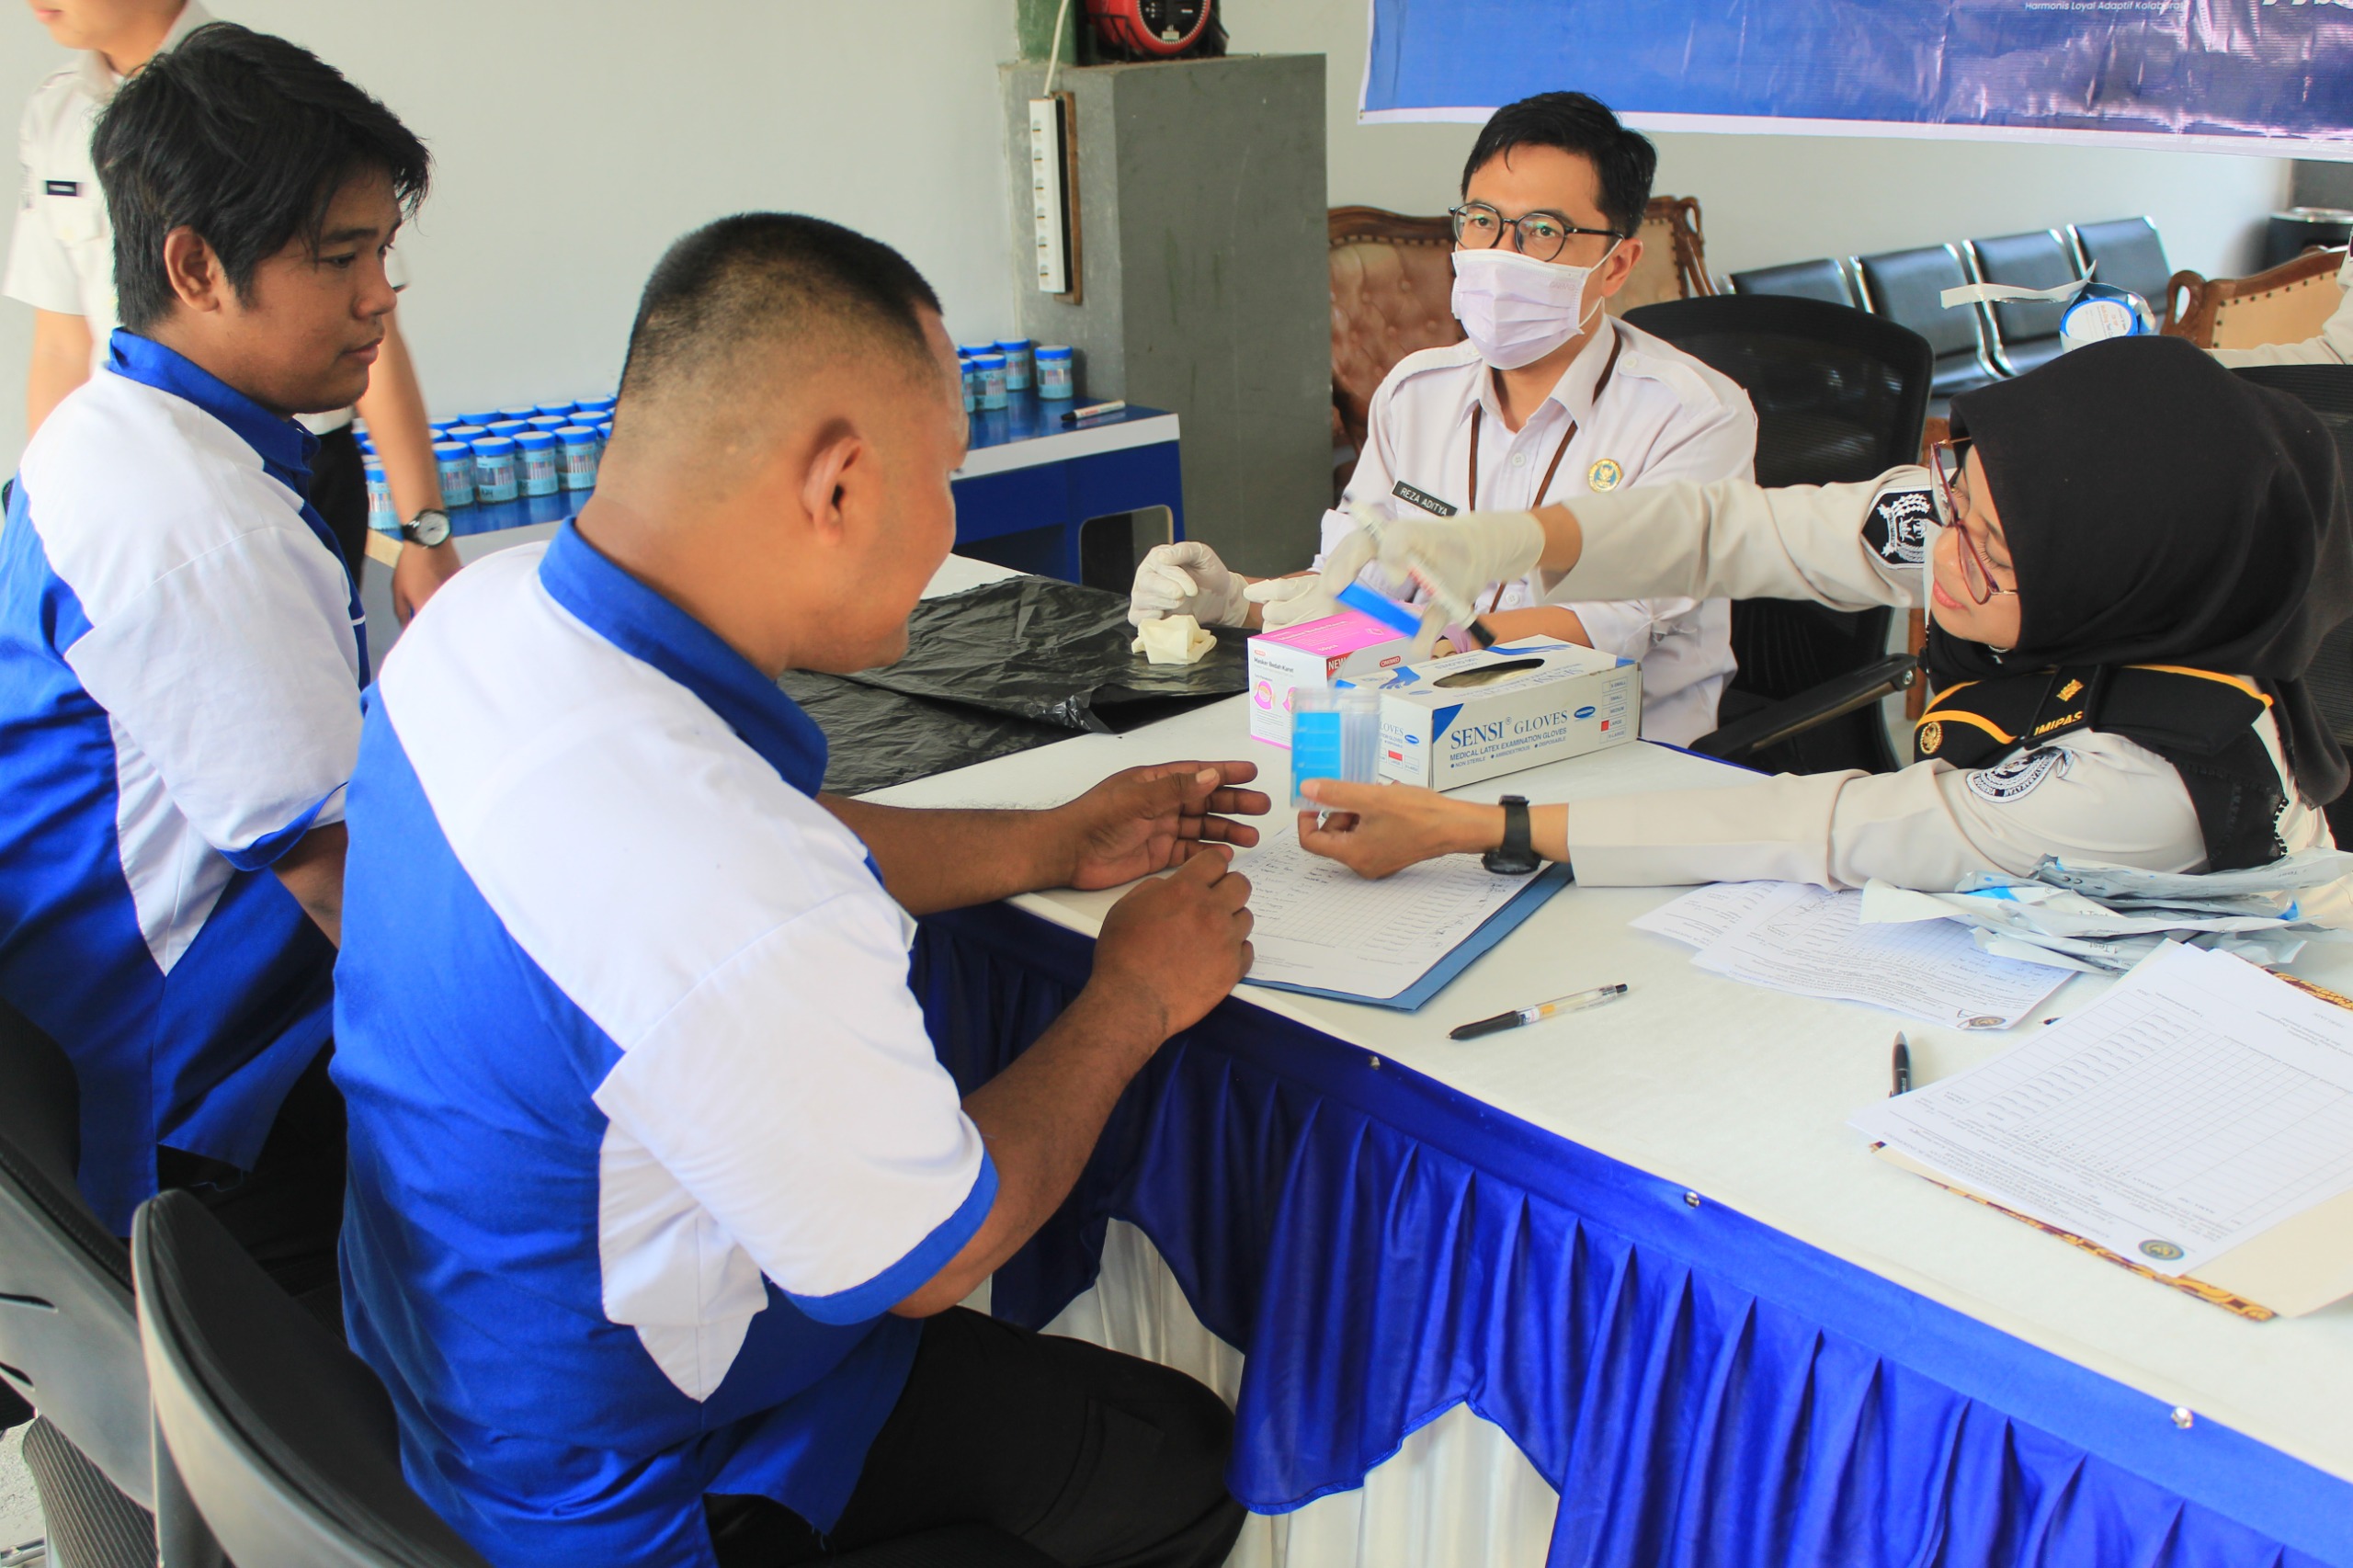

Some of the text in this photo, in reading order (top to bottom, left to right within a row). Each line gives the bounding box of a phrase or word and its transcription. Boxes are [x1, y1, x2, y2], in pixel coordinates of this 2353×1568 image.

[2025, 1, 2069, 11] Harmonis
[2071, 1, 2097, 13] Loyal
[2097, 1, 2133, 13] Adaptif
[1400, 487, 1448, 517] REZA ADITYA
[1254, 656, 1269, 665] Masker
[1380, 721, 1404, 736] LOVES
[1514, 710, 1568, 735] GLOVES
[1609, 719, 1622, 727] LARGE
[2033, 710, 2084, 736] IMIPAS
[1449, 726, 1567, 761] MEDICAL LATEX EXAMINATION GLOVES
[1467, 756, 1486, 766] STERILE
[2089, 942, 2109, 953] Test
